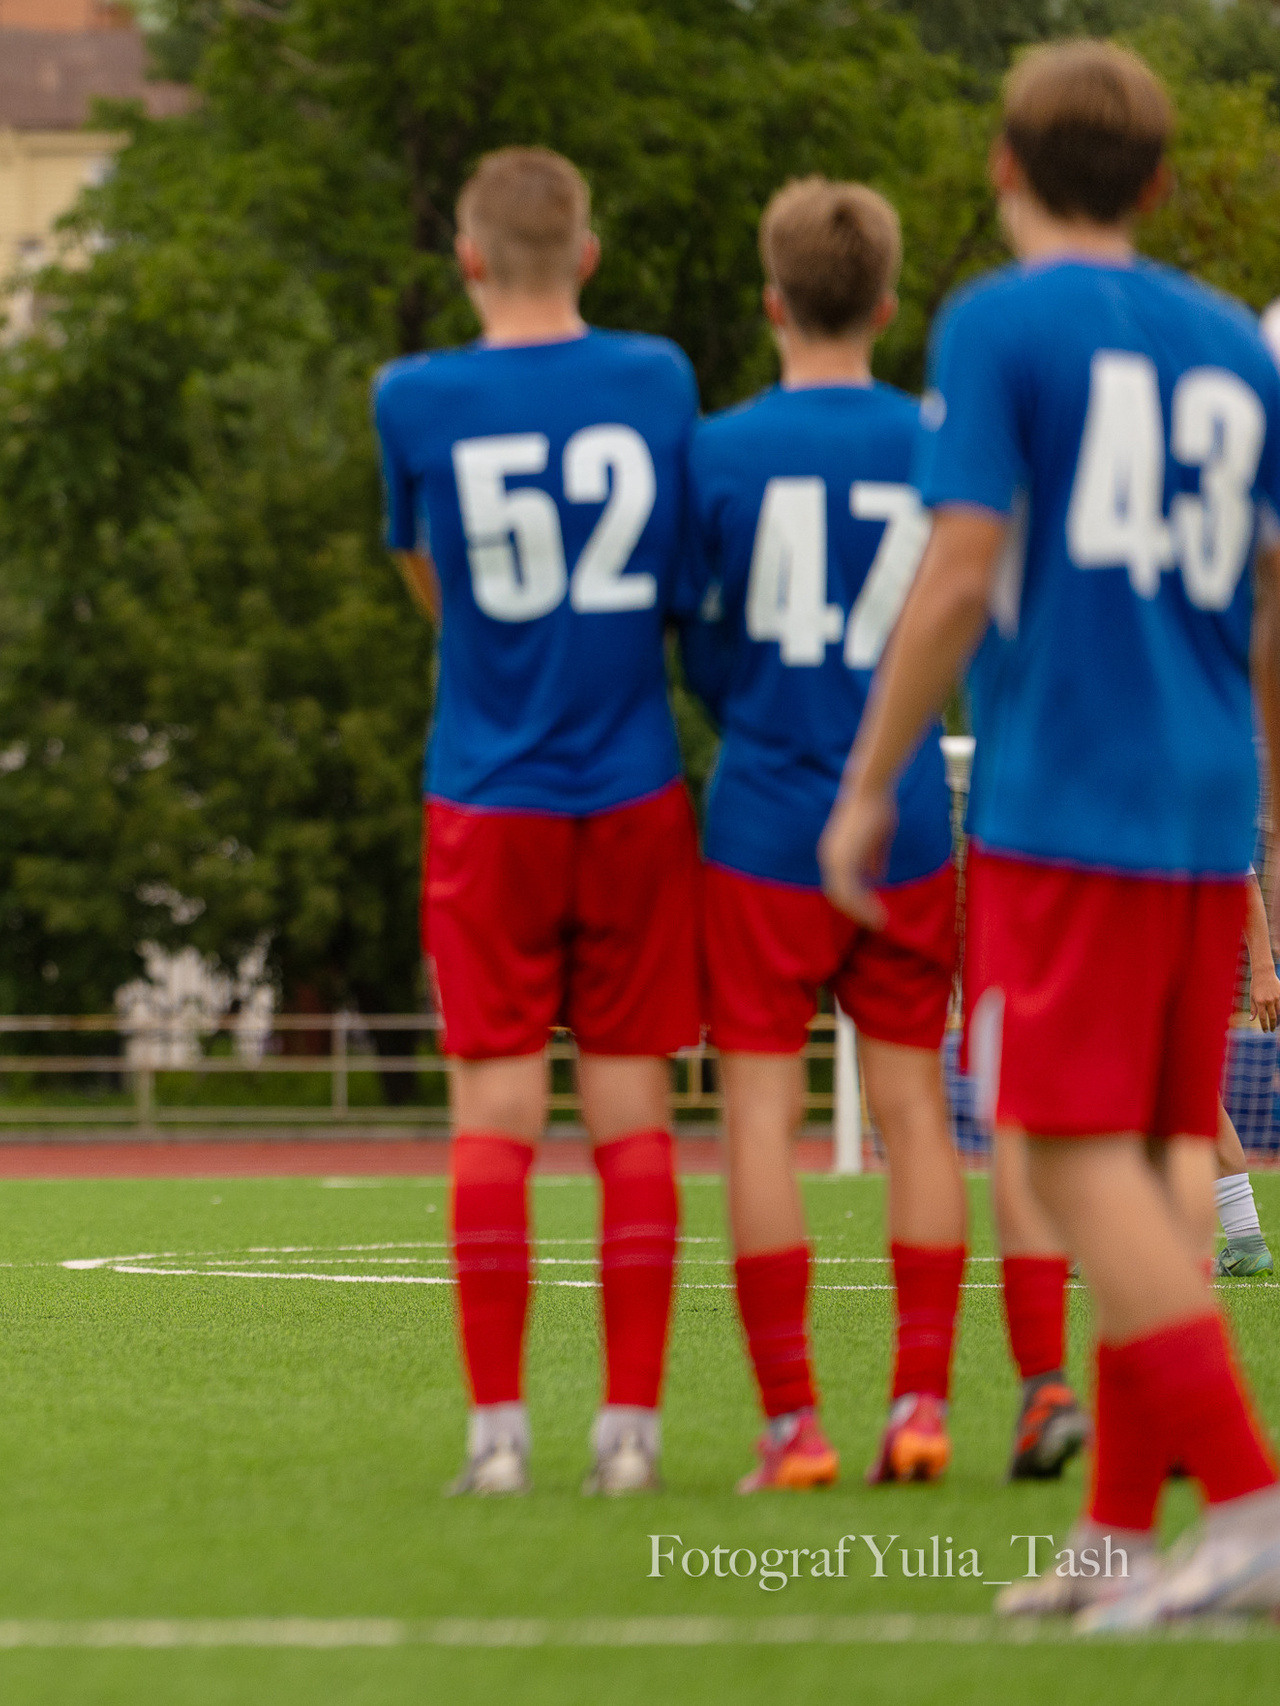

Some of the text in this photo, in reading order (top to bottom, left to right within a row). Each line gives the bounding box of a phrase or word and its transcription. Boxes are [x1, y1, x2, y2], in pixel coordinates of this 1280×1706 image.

[452, 423, 657, 622] 52
[746, 477, 932, 668] 47
[1065, 349, 1266, 611] 43
